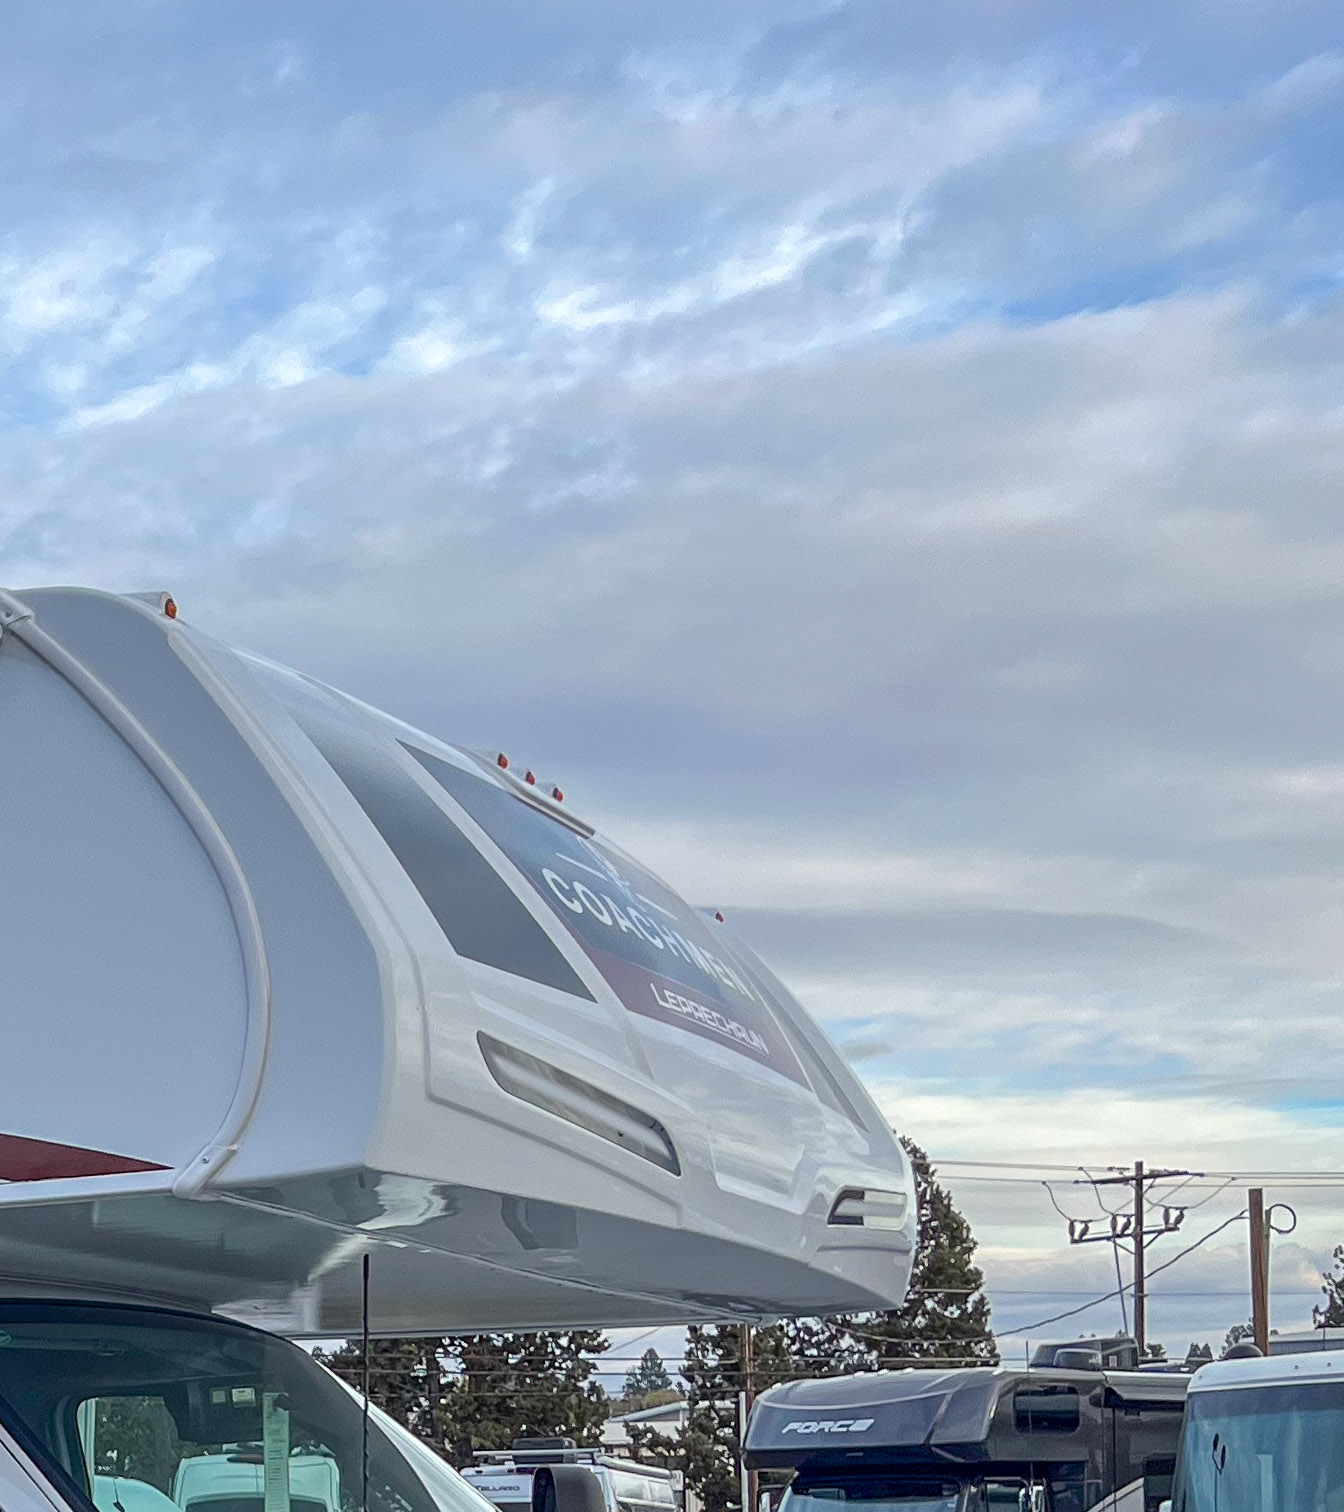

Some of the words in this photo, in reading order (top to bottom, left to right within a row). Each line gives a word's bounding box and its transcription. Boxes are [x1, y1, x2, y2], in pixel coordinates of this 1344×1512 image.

[542, 868, 756, 1003] COACHMEN
[650, 982, 769, 1056] LEPRECHAUN
[781, 1418, 875, 1434] FORCE
